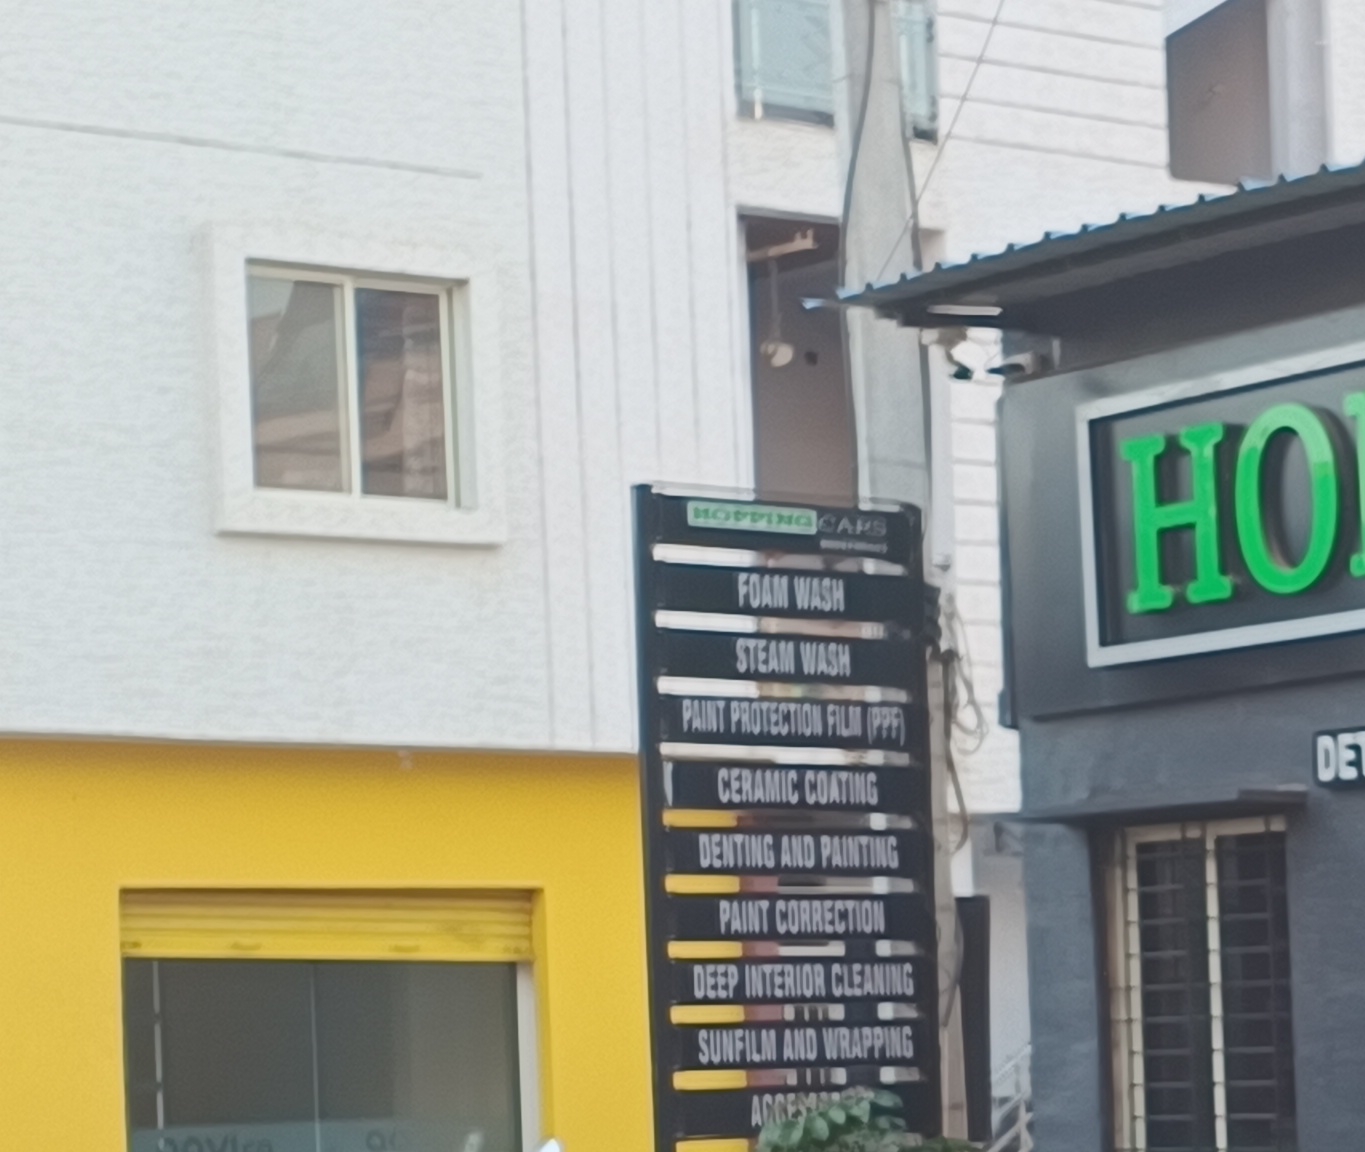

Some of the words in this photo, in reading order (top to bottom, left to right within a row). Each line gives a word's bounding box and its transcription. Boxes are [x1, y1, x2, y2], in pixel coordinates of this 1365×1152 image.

[738, 573, 789, 609] FOAM
[794, 577, 845, 612] WASH
[736, 639, 794, 674] STEAM
[800, 642, 851, 676] WASH
[682, 699, 725, 732] PAINT
[730, 702, 821, 737] PROTECTION
[827, 705, 862, 737] FILM
[718, 768, 799, 803] CERAMIC
[804, 771, 879, 806] COATING
[699, 834, 775, 868] DENTING
[781, 834, 816, 868] AND
[821, 835, 899, 869] PAINTING
[719, 900, 769, 934] PAINT
[775, 900, 885, 934] CORRECTION
[693, 964, 738, 999] DEEP
[745, 964, 826, 997] INTERIOR
[831, 963, 914, 996] CLEANING
[698, 1028, 776, 1064] SUNFILM
[783, 1028, 817, 1062] AND
[823, 1025, 914, 1059] WRAPPING
